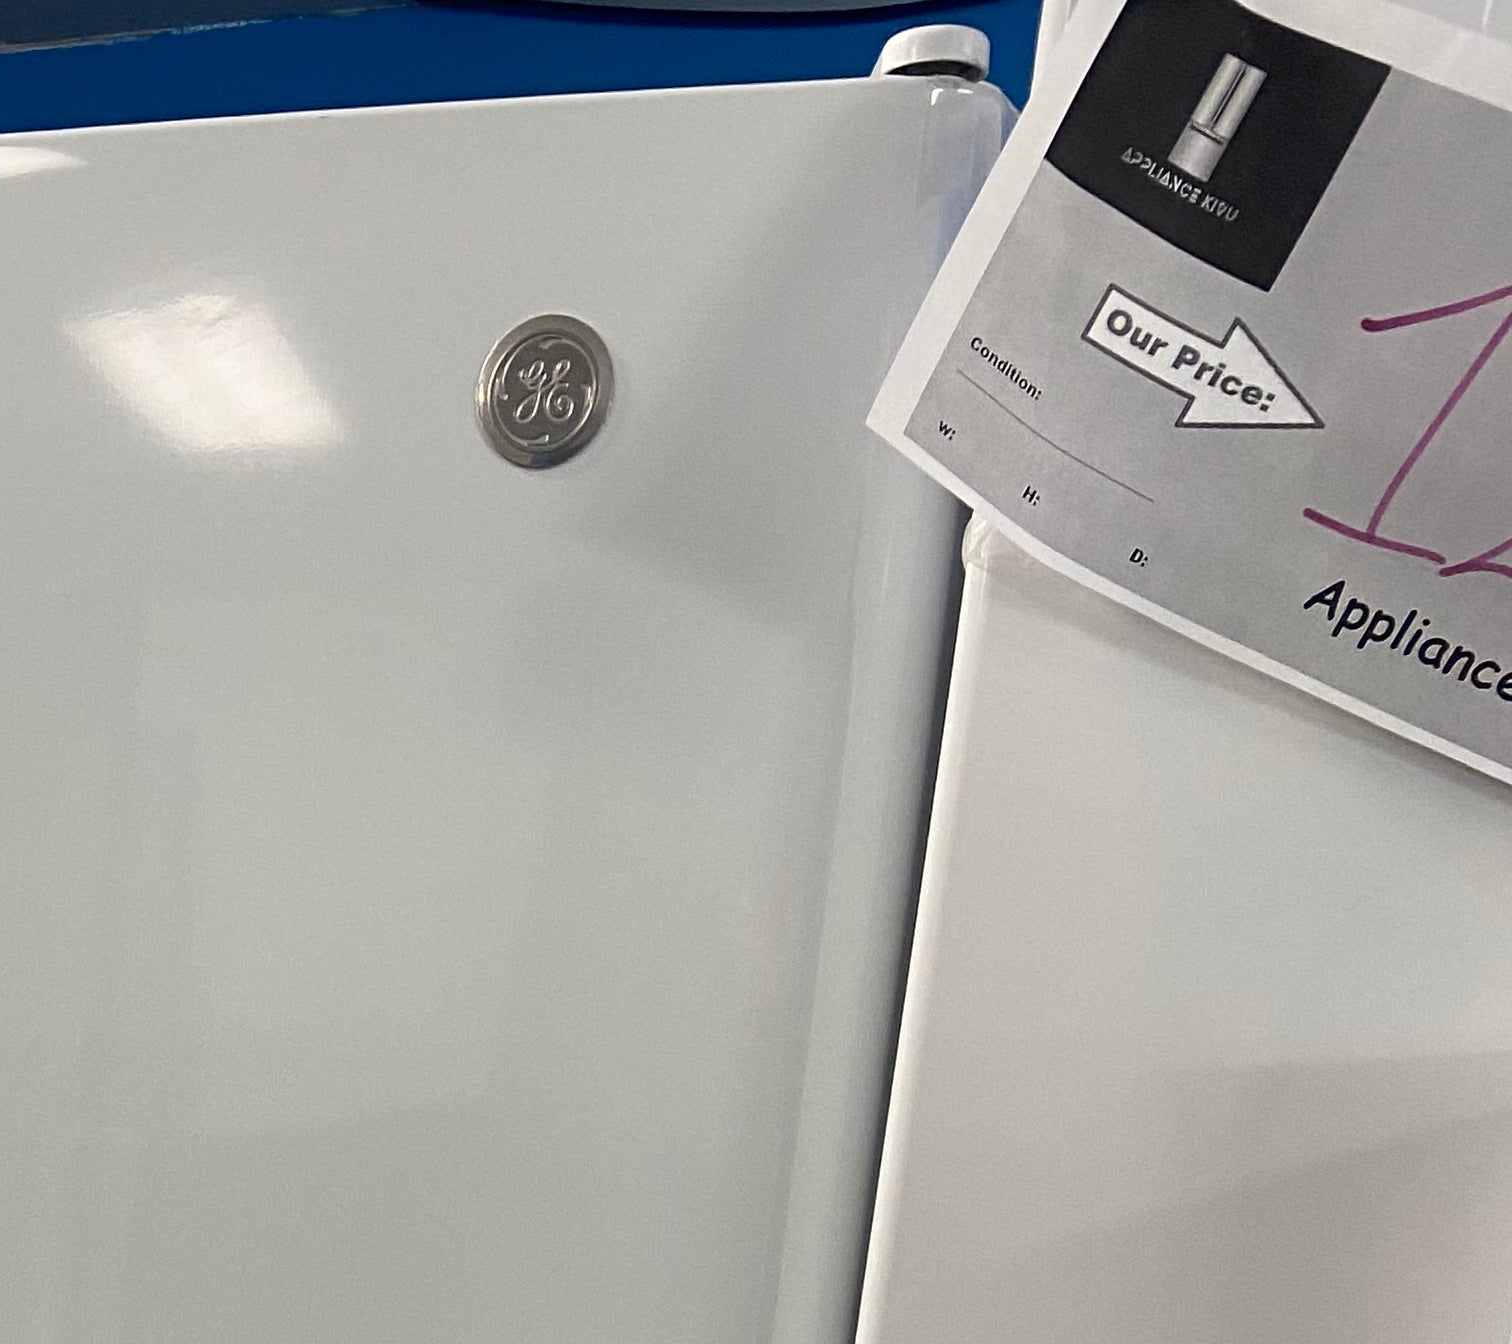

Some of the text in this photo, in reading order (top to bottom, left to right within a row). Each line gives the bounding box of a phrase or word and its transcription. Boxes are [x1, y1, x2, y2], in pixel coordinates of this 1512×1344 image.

[1120, 147, 1202, 204] APPLIANCE
[970, 336, 1042, 401] Condition:
[1106, 309, 1277, 412] Our Price:
[1021, 485, 1041, 507] H:
[1129, 548, 1149, 568] D:
